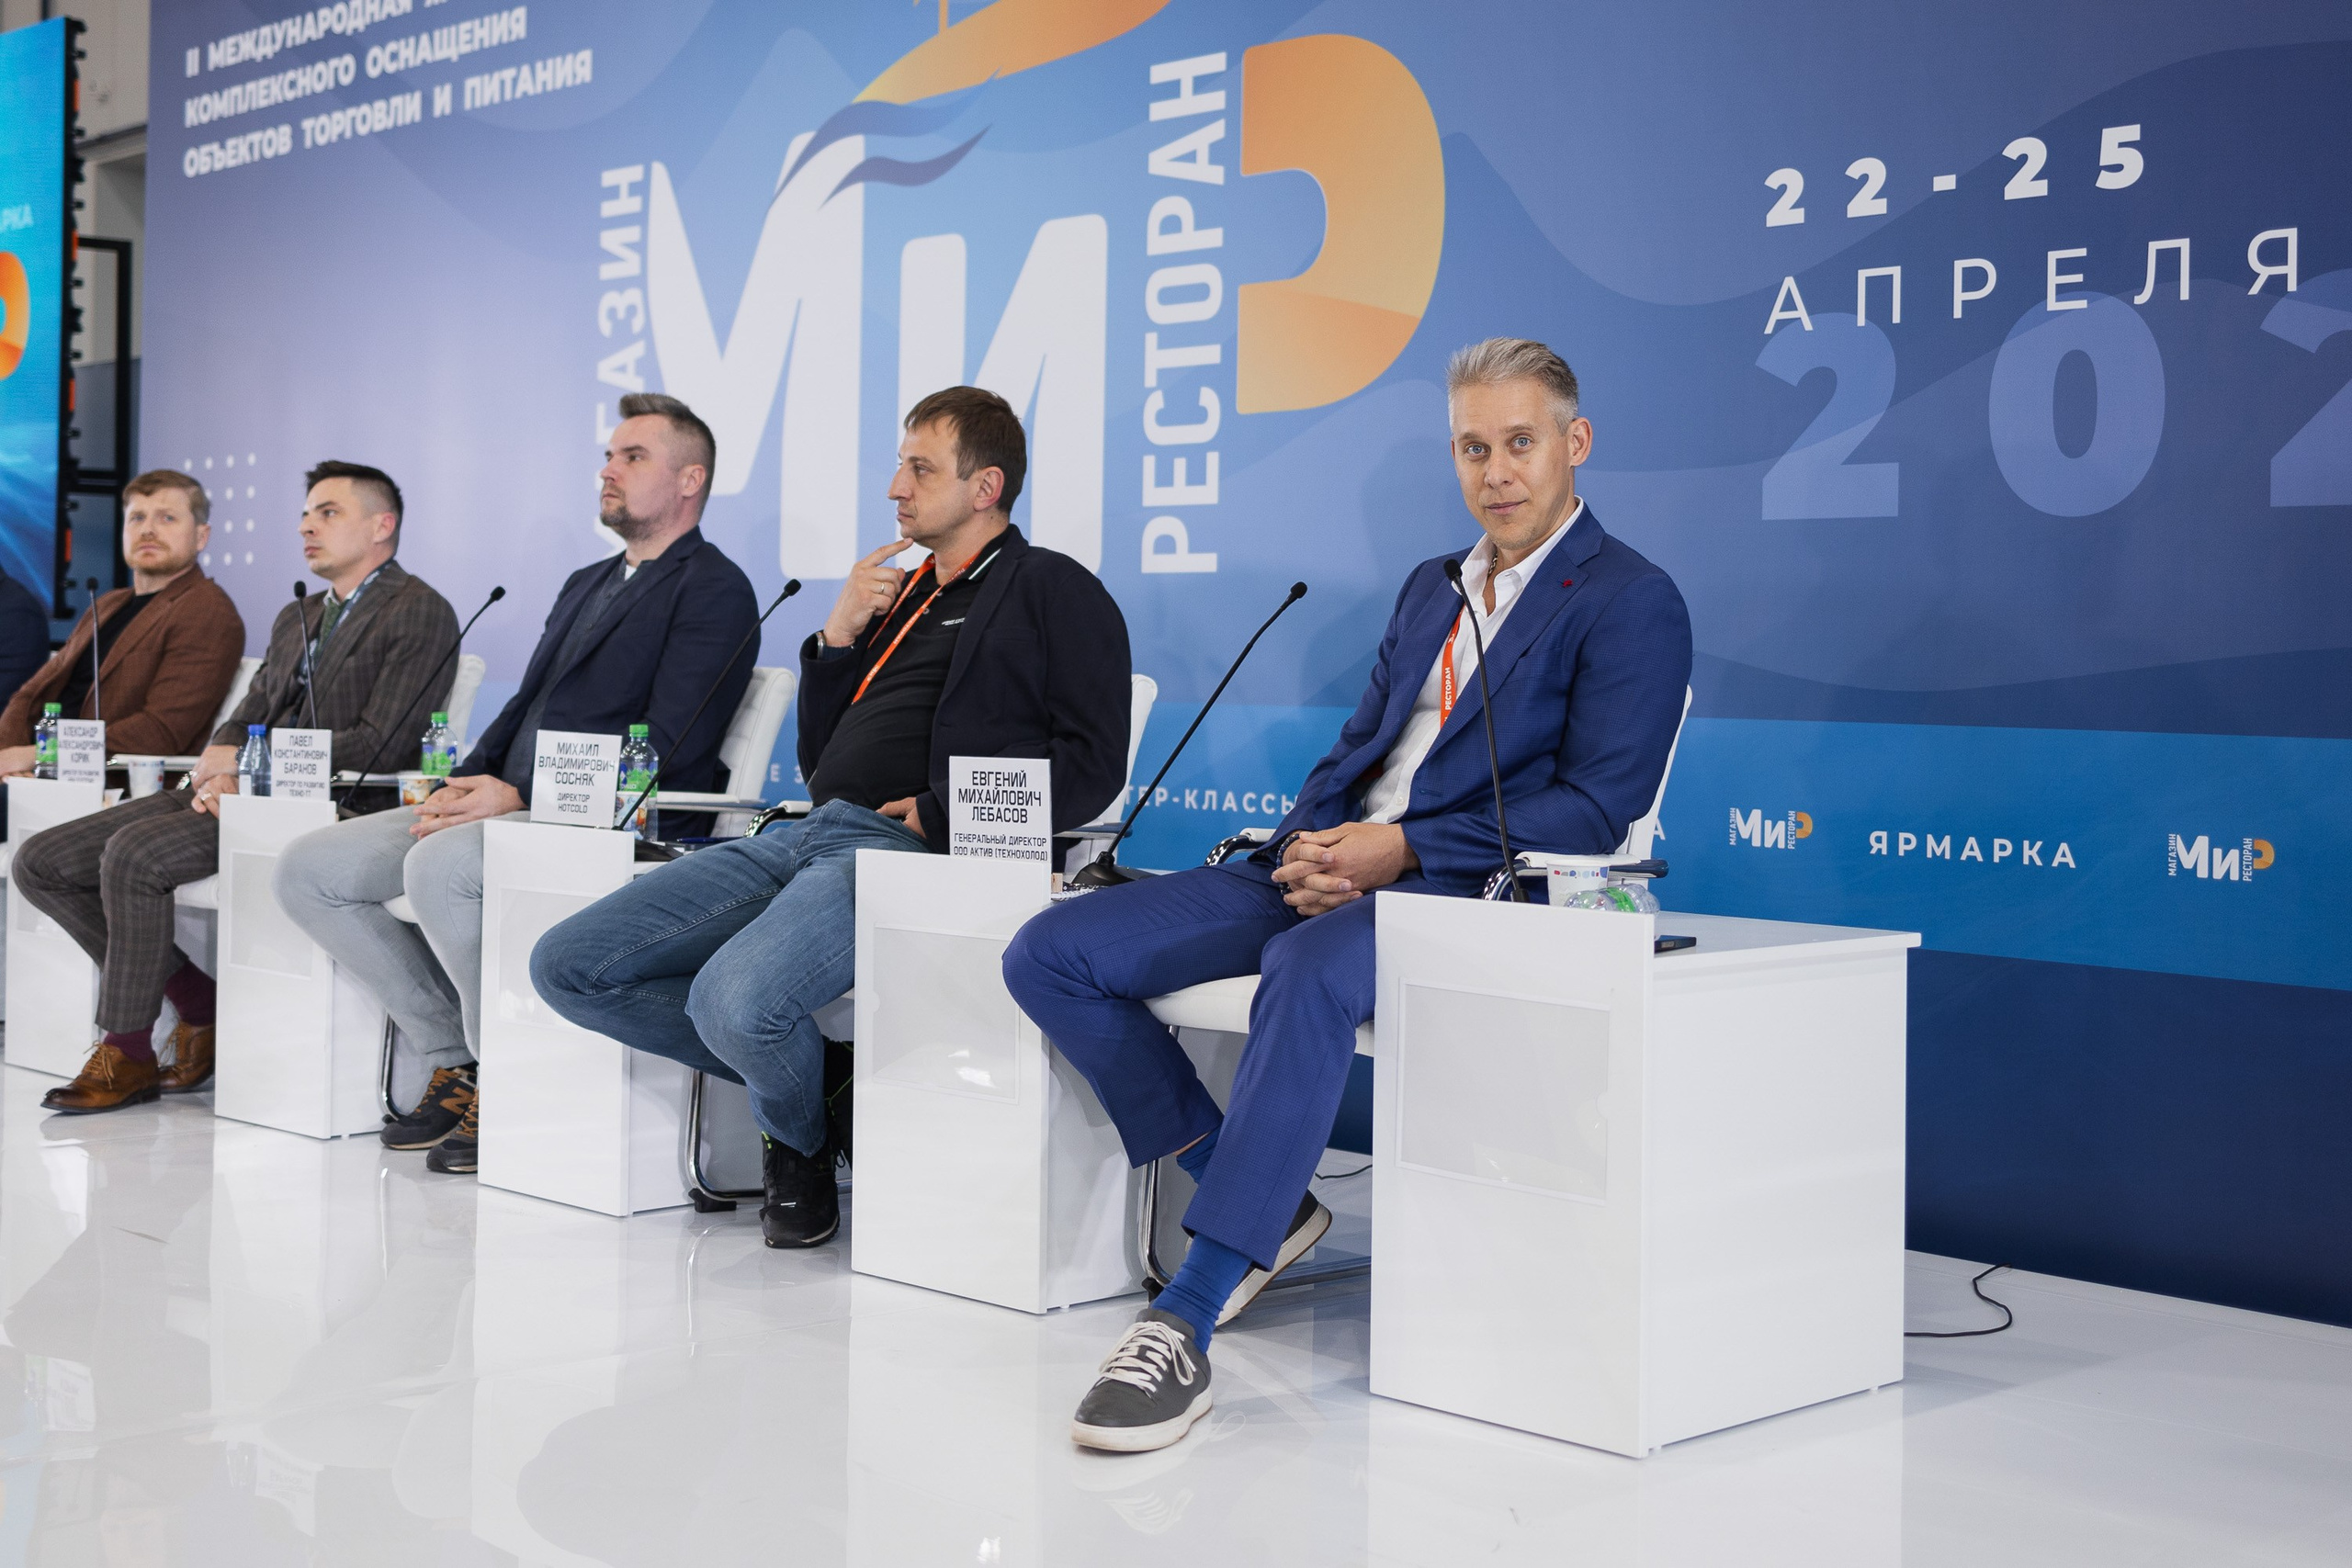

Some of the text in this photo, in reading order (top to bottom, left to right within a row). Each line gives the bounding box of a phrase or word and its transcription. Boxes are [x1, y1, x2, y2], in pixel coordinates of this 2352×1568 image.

[185, 6, 527, 128] КОМПЛЕКСНОГО ОСНАЩЕНИЯ
[184, 49, 593, 178] ОБЪЕКТОВ ТОРГОВЛИ И ПИТАНИЯ
[1763, 124, 2144, 228] 22-25
[1763, 227, 2298, 334] АПРЕЛЯ
[1140, 51, 1227, 574] РЕСТОРАН
[289, 735, 313, 747] ПАВЕЛ
[556, 741, 600, 757] МИХАИЛ
[274, 748, 328, 761] КОНСТАНТИНОВИЧ
[283, 761, 318, 775] БАРАНОВ
[538, 755, 616, 773] ВЛАДИМИРОВИЧ
[554, 771, 596, 786] СОСНЯК
[971, 769, 1027, 788] ЕВГЕНИЙ
[557, 792, 591, 803] ДИРЕКТОР
[957, 786, 1042, 807] МИХАЙЛОВИЧ
[558, 803, 589, 814] HOTCOLD
[971, 806, 1028, 824] ЛЕБАСОВ
[1787, 810, 1796, 850] РЕСТОРАН
[954, 832, 1047, 847] ГЕНЕРАЛЬНЫЙ ДИРЕКТОР
[953, 845, 1048, 862] ООО АКТИВ (ТЕХНОХОЛОД)
[1869, 830, 2076, 869] ЯРМАРКА
[2167, 833, 2177, 876] МАГАЗИН
[2242, 837, 2253, 882] РЕСТОРАН
